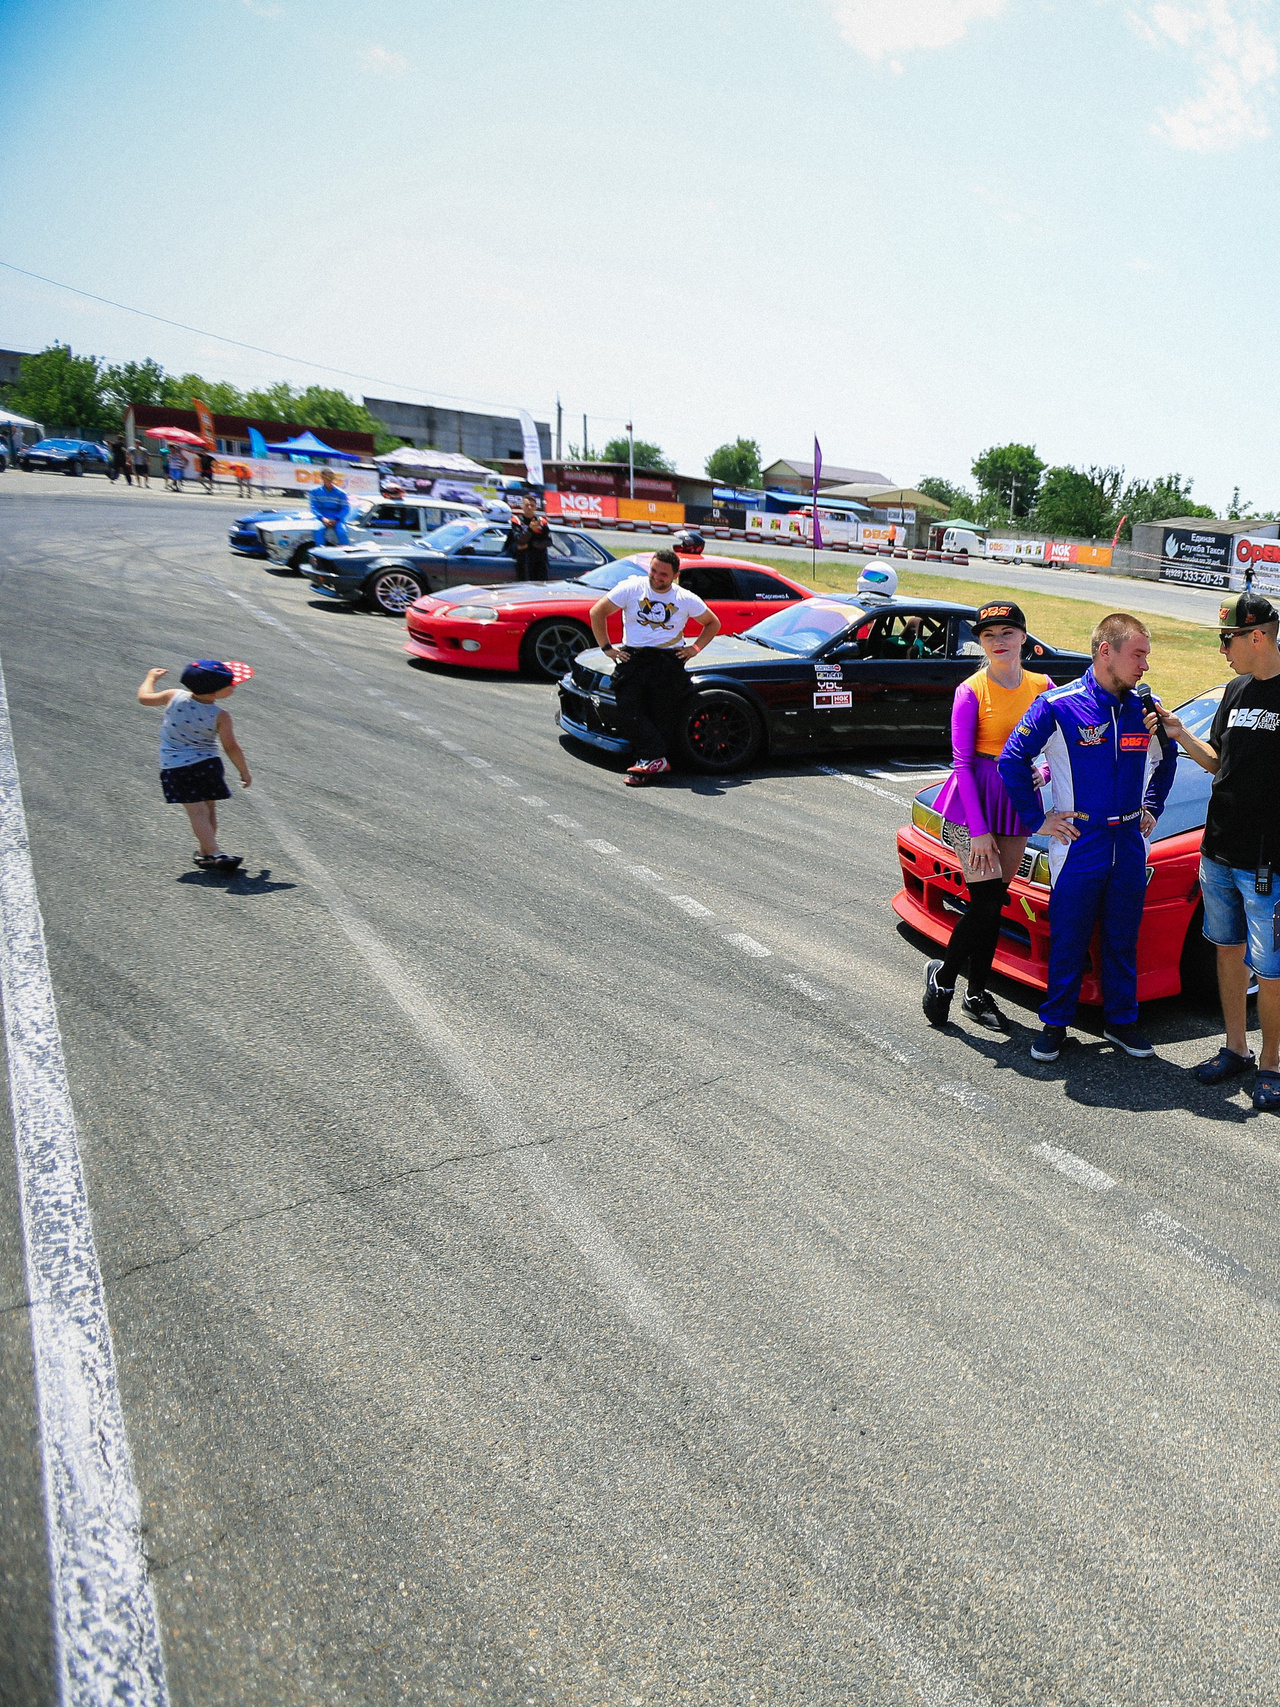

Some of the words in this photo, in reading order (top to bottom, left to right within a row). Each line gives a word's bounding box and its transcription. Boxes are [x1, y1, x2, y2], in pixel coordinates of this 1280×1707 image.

[560, 494, 603, 511] NGK
[1190, 533, 1216, 543] Единая
[1051, 544, 1070, 556] NGK
[1180, 543, 1206, 553] Служба
[1206, 545, 1226, 555] Такси
[980, 606, 1012, 620] DBS
[1227, 708, 1265, 729] DBS
